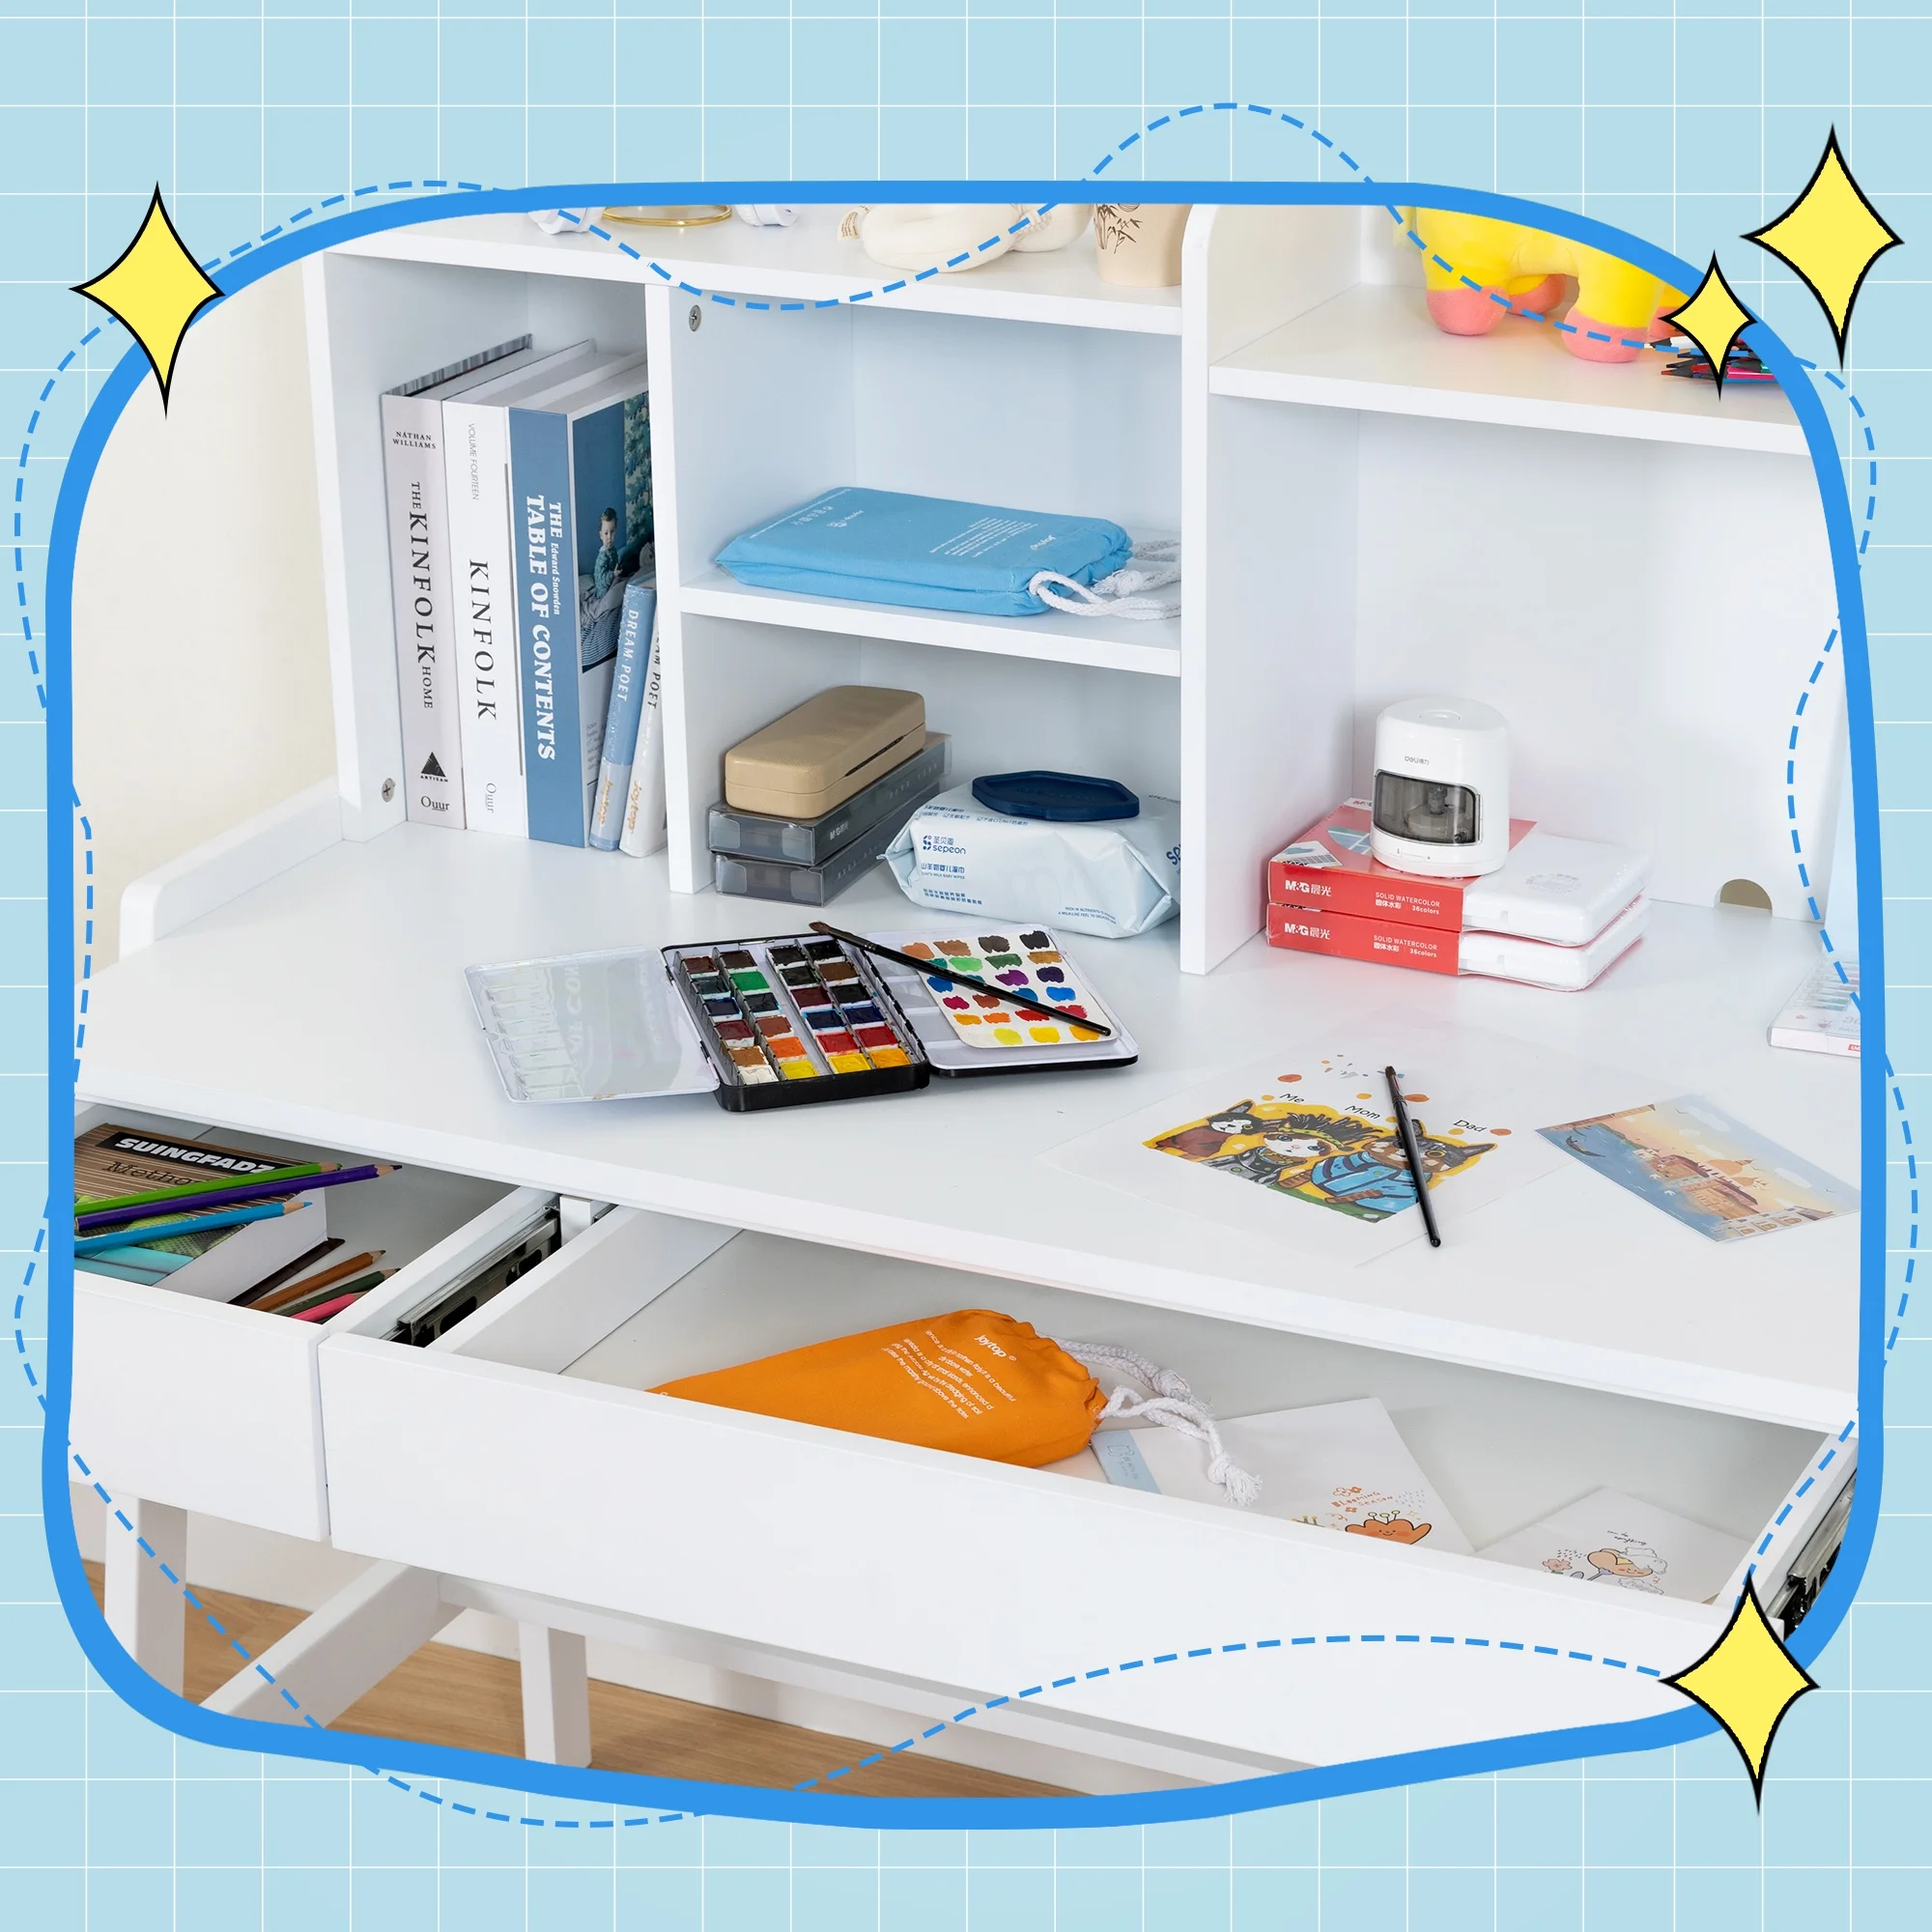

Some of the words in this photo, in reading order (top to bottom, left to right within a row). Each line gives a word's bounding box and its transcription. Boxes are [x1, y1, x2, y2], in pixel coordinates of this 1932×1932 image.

[392, 439, 437, 449] WILLIAMS
[395, 431, 432, 440] NATHAN
[468, 423, 477, 456] VOLUME
[412, 481, 421, 510] THE
[470, 460, 479, 500] FOURTEEN
[526, 495, 548, 576] TABLE
[549, 502, 562, 539] THE
[551, 542, 560, 574] Edward
[410, 511, 435, 664] KINFOLK
[530, 582, 549, 618] OF
[469, 559, 497, 720] KINFOLK
[622, 610, 639, 662] DREAM
[421, 667, 433, 709] HOME
[532, 624, 555, 760] CONTENTS
[617, 663, 632, 702] POET
[647, 672, 661, 709] POET
[421, 796, 450, 810] Ouur
[486, 782, 497, 812] Ouur
[933, 844, 966, 854] sepeon
[1285, 879, 1332, 897] M&G晨光
[1376, 892, 1395, 900] SOLID
[1395, 895, 1440, 908] WATERCOLOR
[1375, 898, 1402, 910] 固体水彩
[1412, 904, 1439, 916] 36colors
[1285, 923, 1331, 941] M&G晨光
[1374, 935, 1393, 944] SOLID
[1393, 937, 1437, 951] WATERCOLOR
[1374, 942, 1400, 952] 固体水彩
[1409, 948, 1437, 958] 36colors
[1279, 1093, 1304, 1103] Me
[1345, 1105, 1381, 1120] Mom
[1453, 1119, 1488, 1132] Dad
